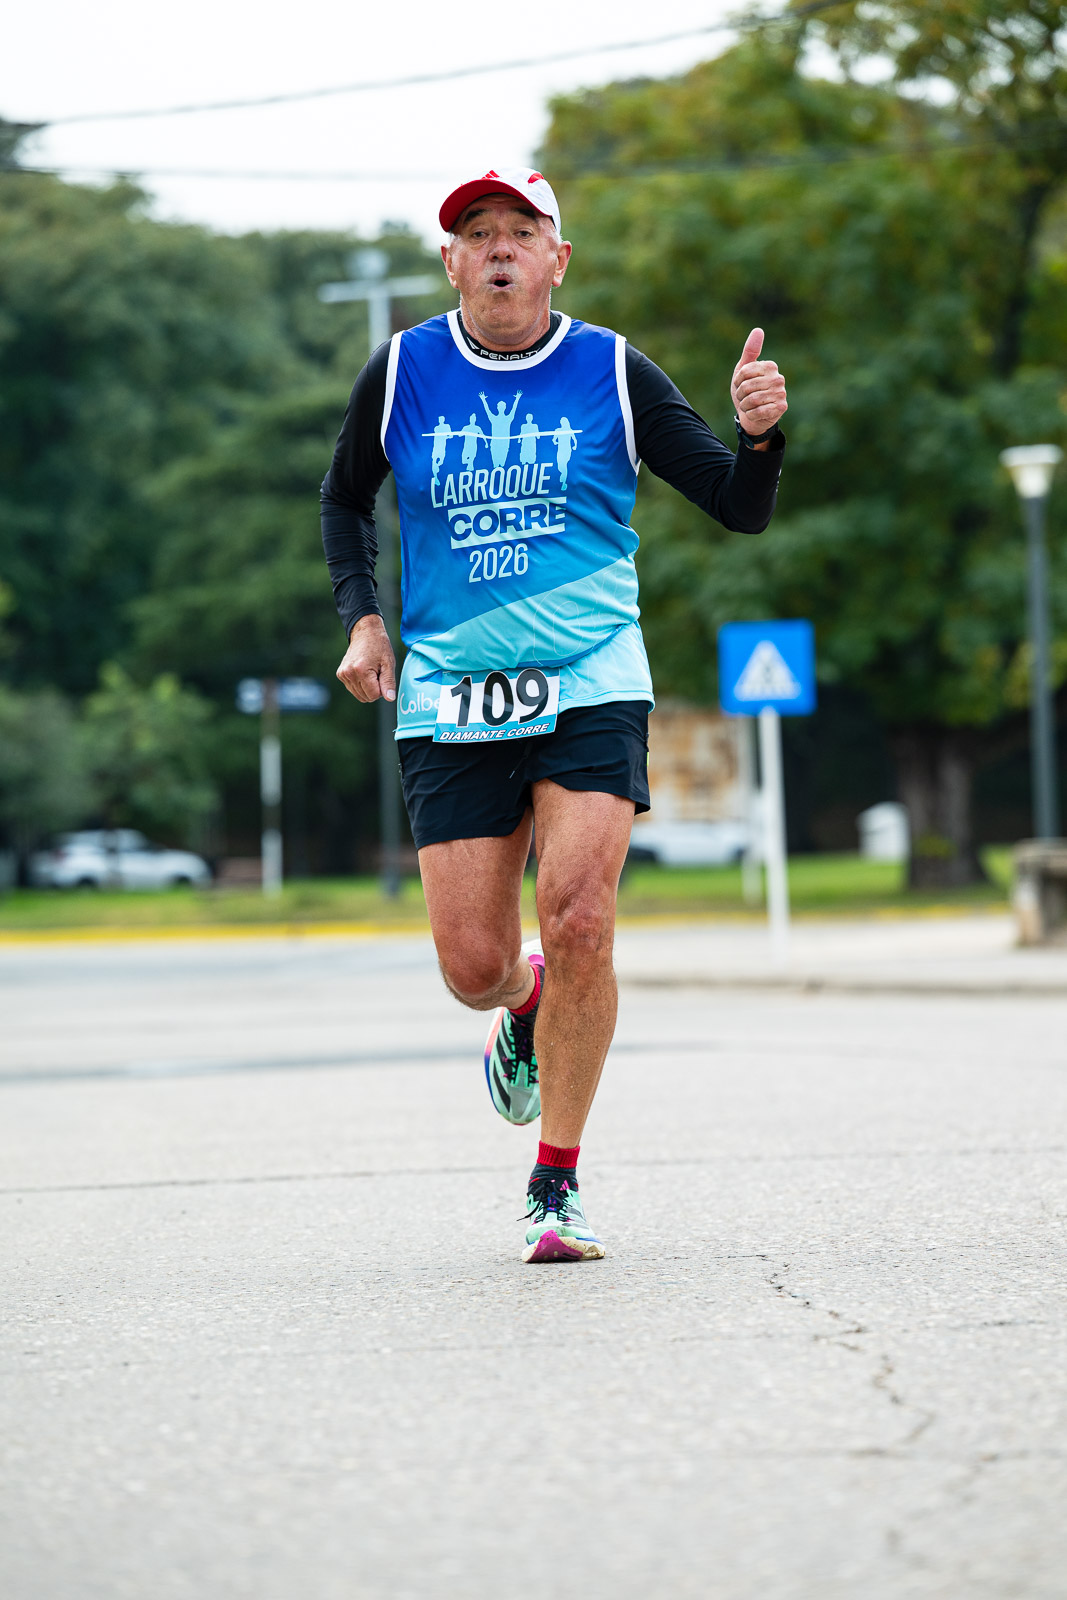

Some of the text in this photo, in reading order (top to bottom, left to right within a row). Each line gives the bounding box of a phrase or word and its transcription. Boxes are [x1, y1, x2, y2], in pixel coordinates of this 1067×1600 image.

[431, 463, 553, 508] LARROQUE
[449, 503, 566, 541] CORRE
[469, 543, 529, 583] 2026
[451, 668, 549, 728] 109
[439, 723, 550, 741] DIAMANTE CORRE
